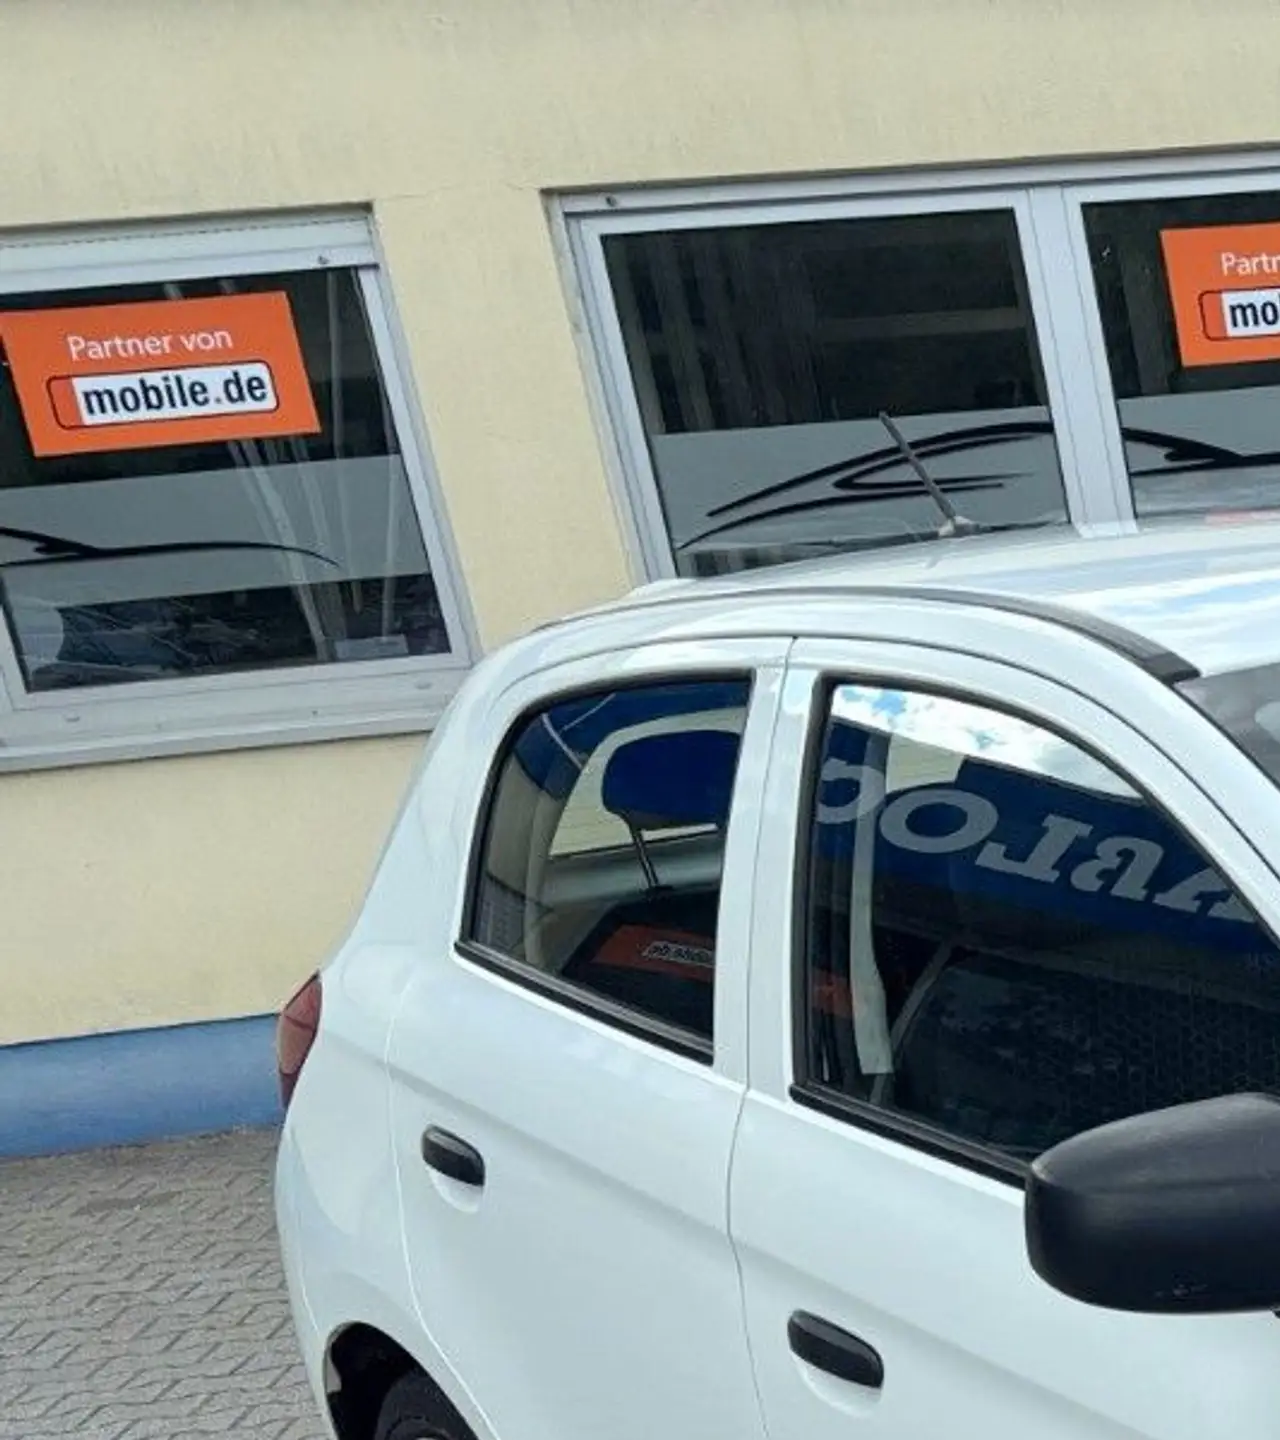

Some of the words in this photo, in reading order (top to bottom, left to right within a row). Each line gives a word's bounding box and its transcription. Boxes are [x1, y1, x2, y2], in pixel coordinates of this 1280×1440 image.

[66, 333, 173, 362] Partner
[184, 328, 233, 352] von
[82, 371, 268, 417] mobile.de
